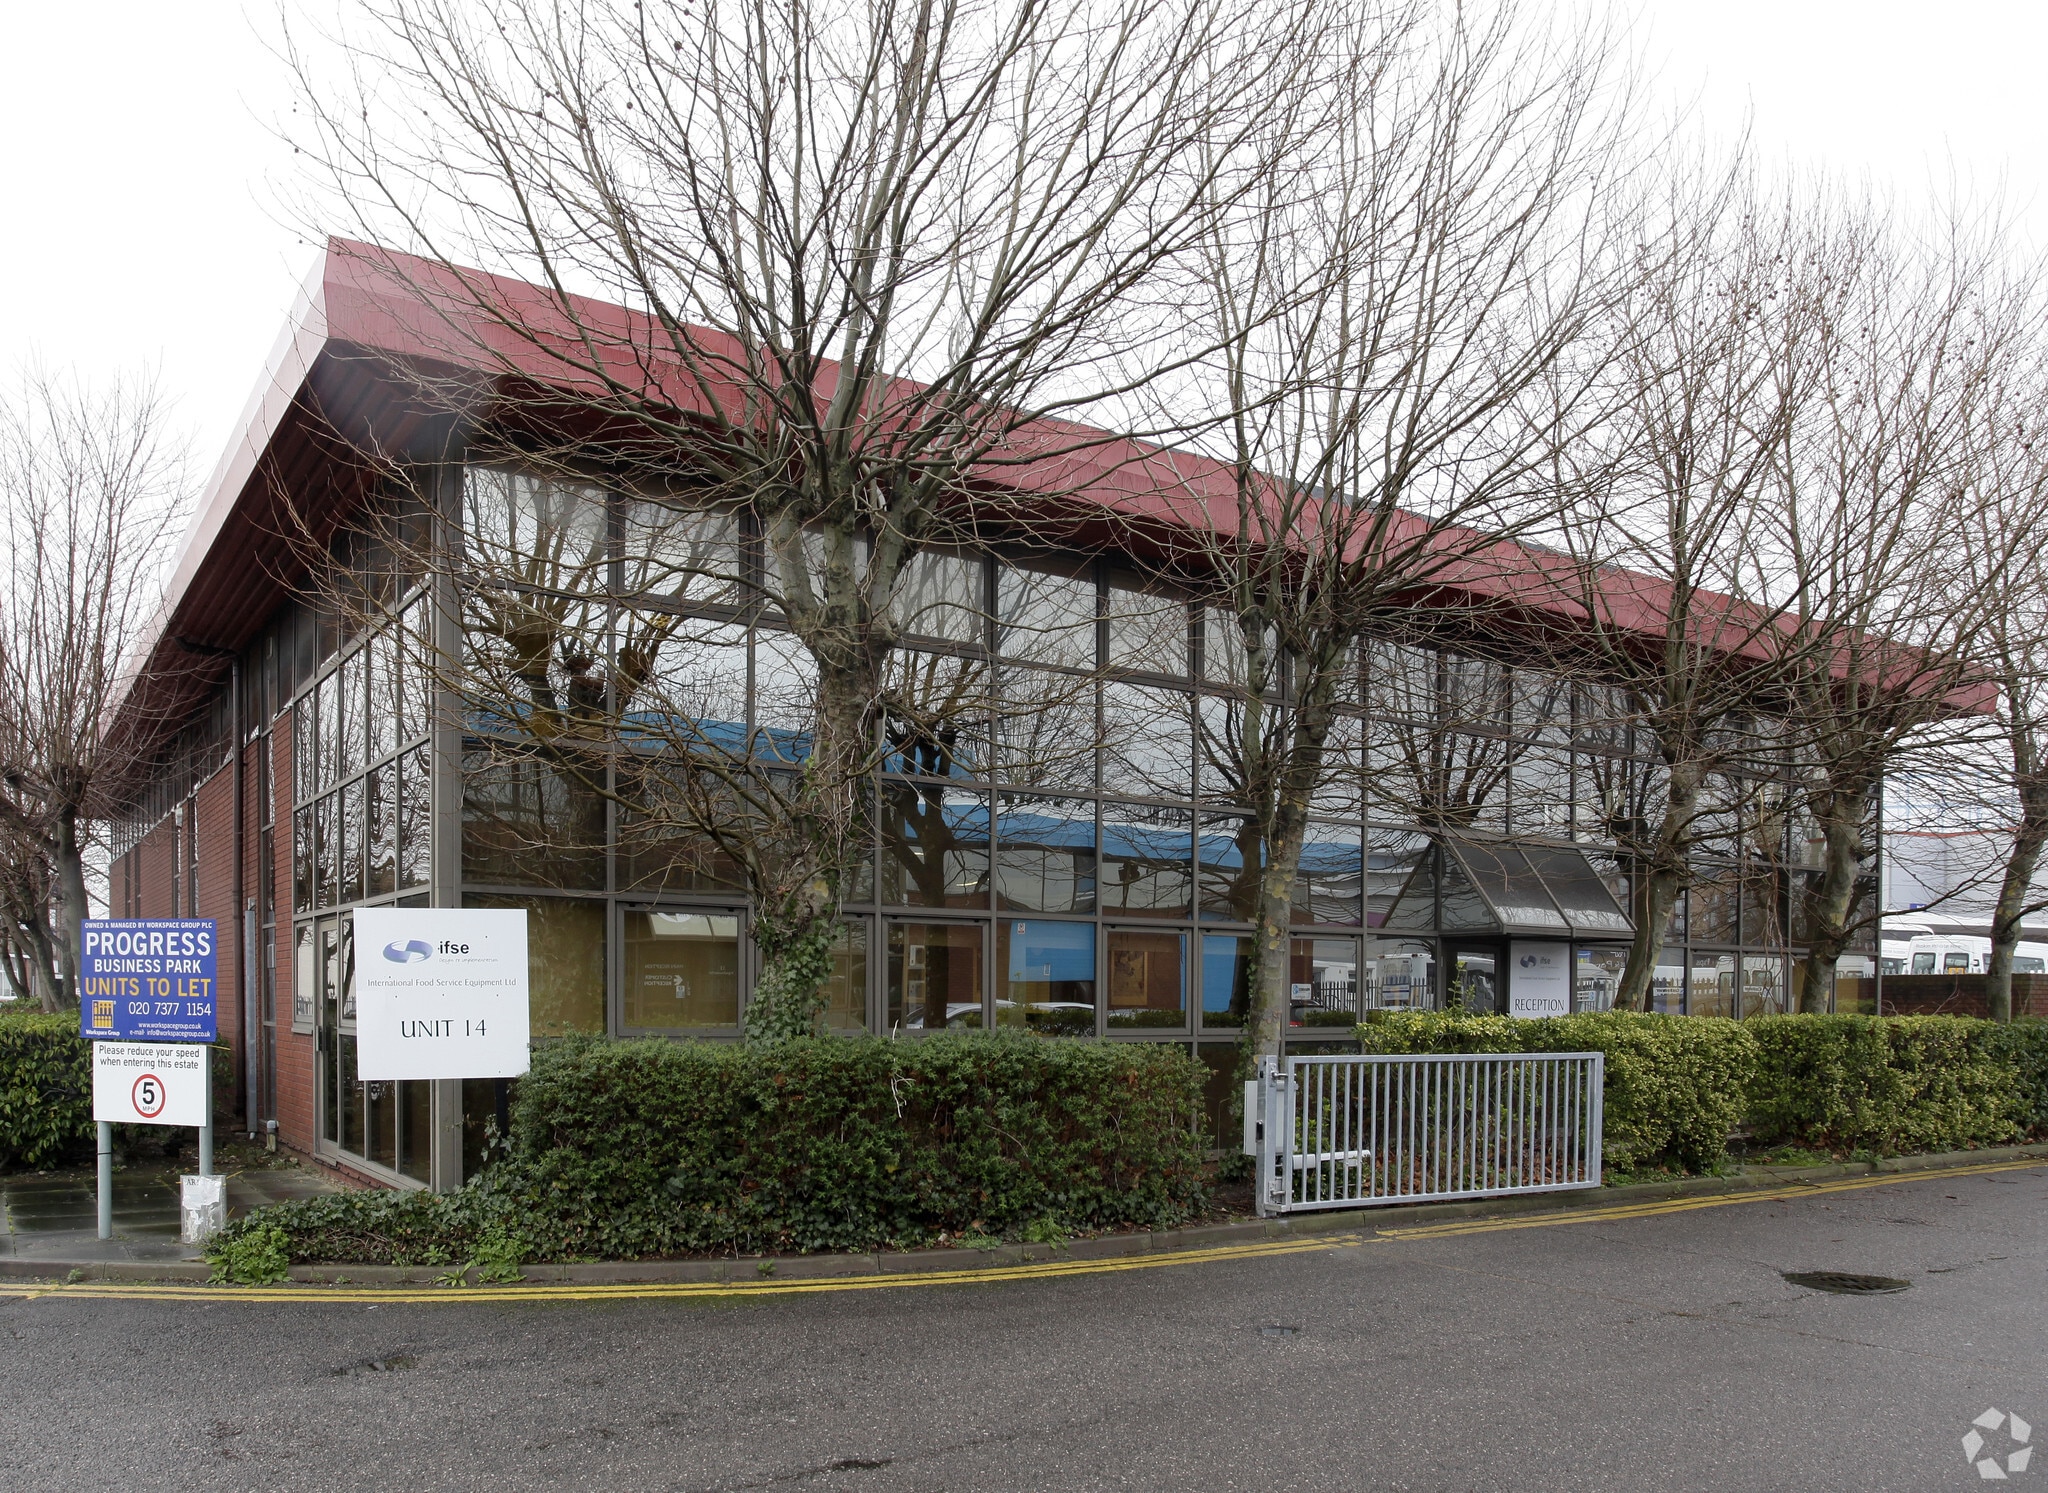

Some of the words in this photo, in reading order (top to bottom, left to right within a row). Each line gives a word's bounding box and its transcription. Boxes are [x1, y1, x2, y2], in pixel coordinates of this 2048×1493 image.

[86, 932, 211, 956] PROGRESS
[439, 940, 470, 954] ifse
[94, 959, 161, 972] BUSINESS
[166, 960, 202, 974] PARK
[85, 977, 140, 996] UNITS
[146, 978, 171, 997] TO
[178, 978, 212, 997] LET
[367, 978, 414, 987] International
[416, 978, 434, 987] Food
[436, 978, 463, 987] Service
[464, 978, 502, 988] Equipment
[505, 978, 517, 986] Ltd
[128, 1002, 150, 1014] 020
[154, 1002, 180, 1016] 7377
[186, 1003, 212, 1016] 1154
[1514, 998, 1565, 1011] RECEPTION
[138, 1022, 202, 1030] www.workspacegroup.co.uk
[401, 1020, 454, 1038] UNIT
[466, 1019, 487, 1038] 14
[146, 1029, 210, 1038] info@workspacegroup.co.uk
[99, 1045, 125, 1055] Please
[127, 1047, 153, 1056] reduce
[156, 1049, 174, 1058] your
[176, 1048, 200, 1060] speed
[100, 1057, 121, 1066] when
[124, 1058, 156, 1070] entering
[158, 1058, 172, 1068] this
[174, 1059, 199, 1069] estate
[142, 1082, 155, 1104] 5
